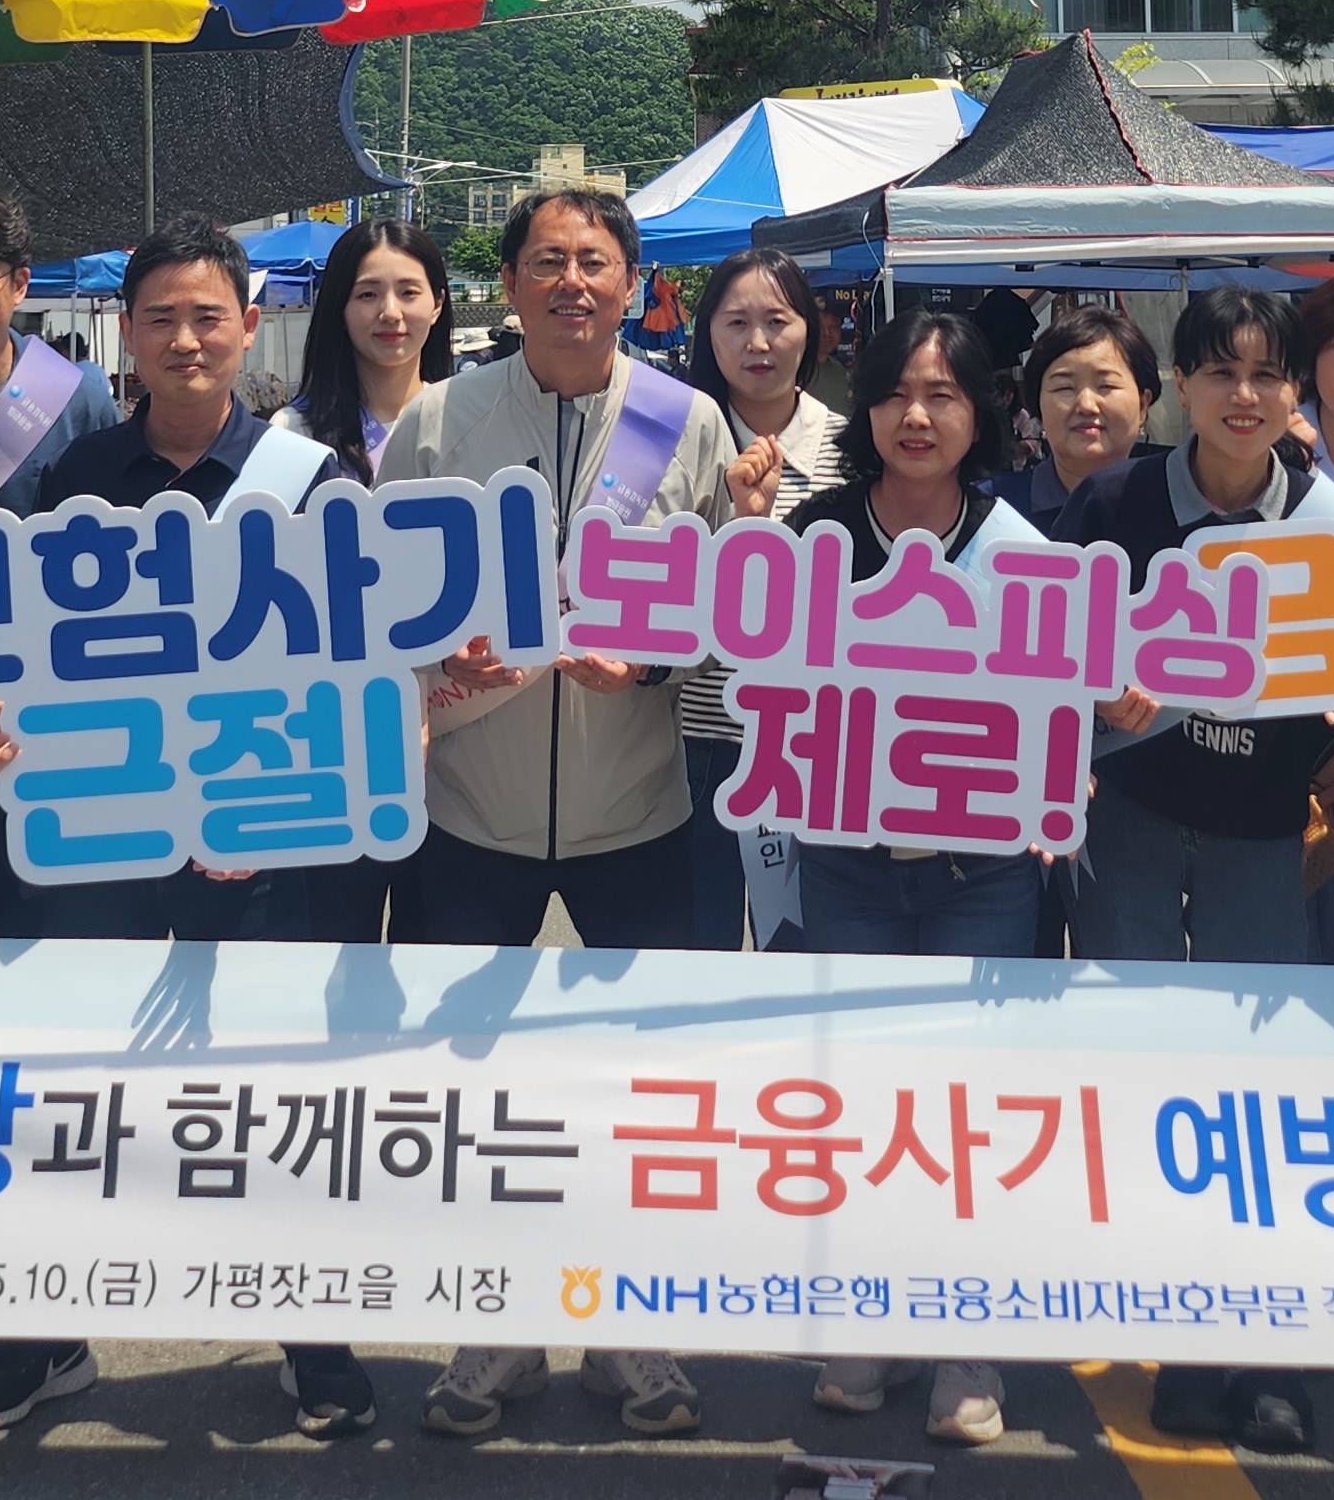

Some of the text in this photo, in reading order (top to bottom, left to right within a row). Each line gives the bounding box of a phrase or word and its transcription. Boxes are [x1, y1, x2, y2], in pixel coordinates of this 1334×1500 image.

[568, 518, 1259, 698] 보이스피싱
[14, 677, 410, 867] 근절!
[727, 683, 1081, 842] 제로!
[1182, 716, 1255, 756] TENNIS
[167, 1081, 579, 1202] 함께하는
[612, 1077, 1110, 1224] 금융사기
[183, 1260, 398, 1310] 가평잣고을
[425, 1263, 512, 1314] 시장
[614, 1271, 891, 1317] NH농협은행
[905, 1274, 1310, 1331] 금융소비자보호부문
